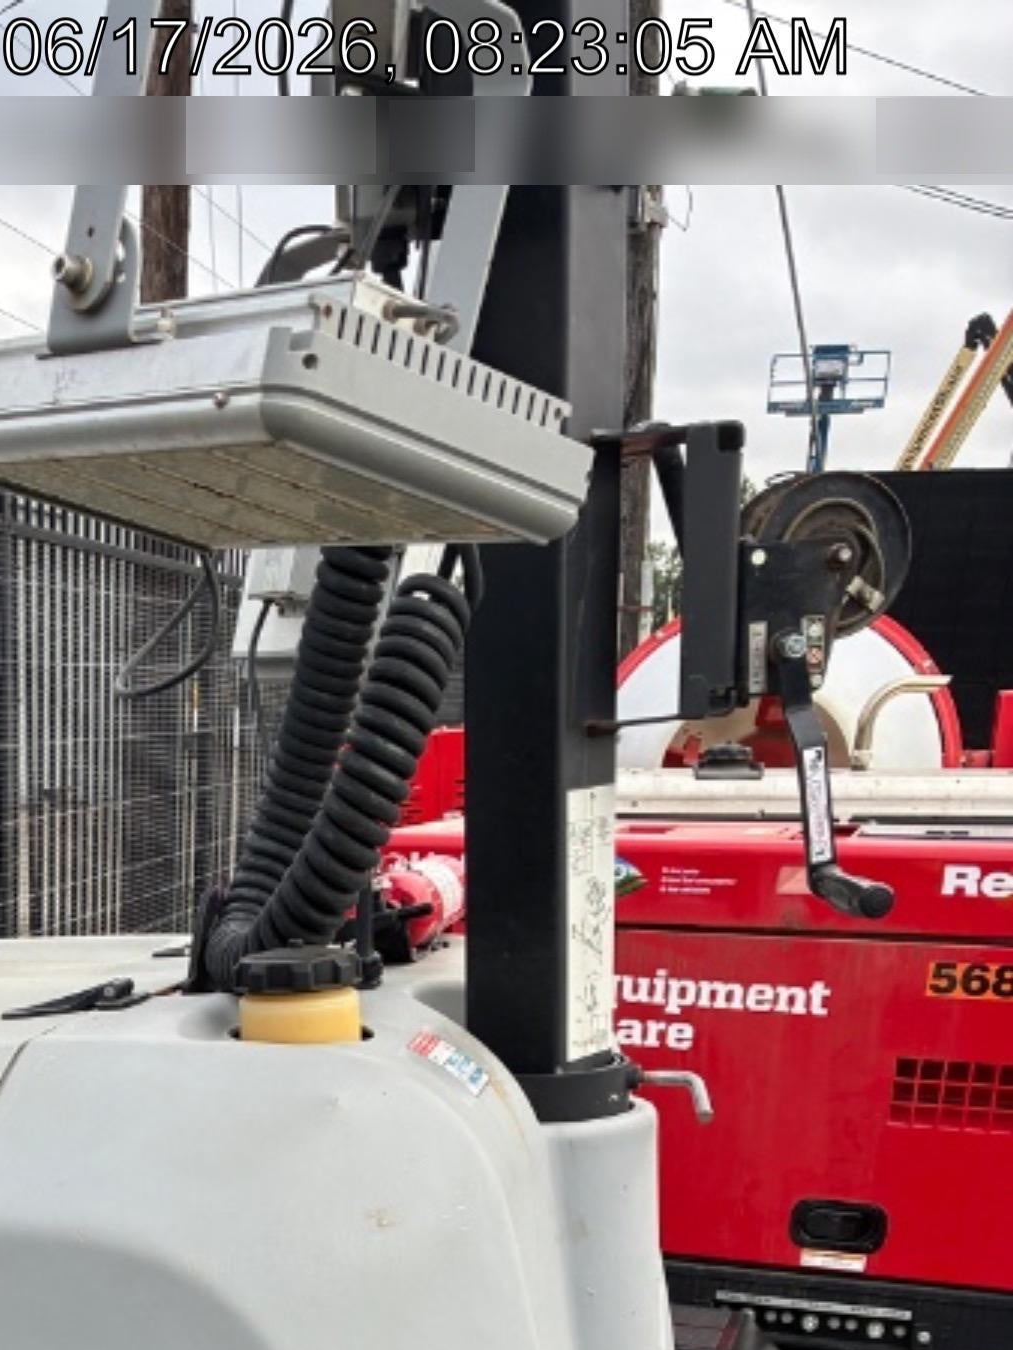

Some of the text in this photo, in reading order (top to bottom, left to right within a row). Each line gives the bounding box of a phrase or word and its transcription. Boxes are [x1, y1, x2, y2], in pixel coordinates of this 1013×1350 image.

[613, 968, 832, 1016] uipment
[929, 962, 1013, 997] 568
[613, 1017, 694, 1051] are
